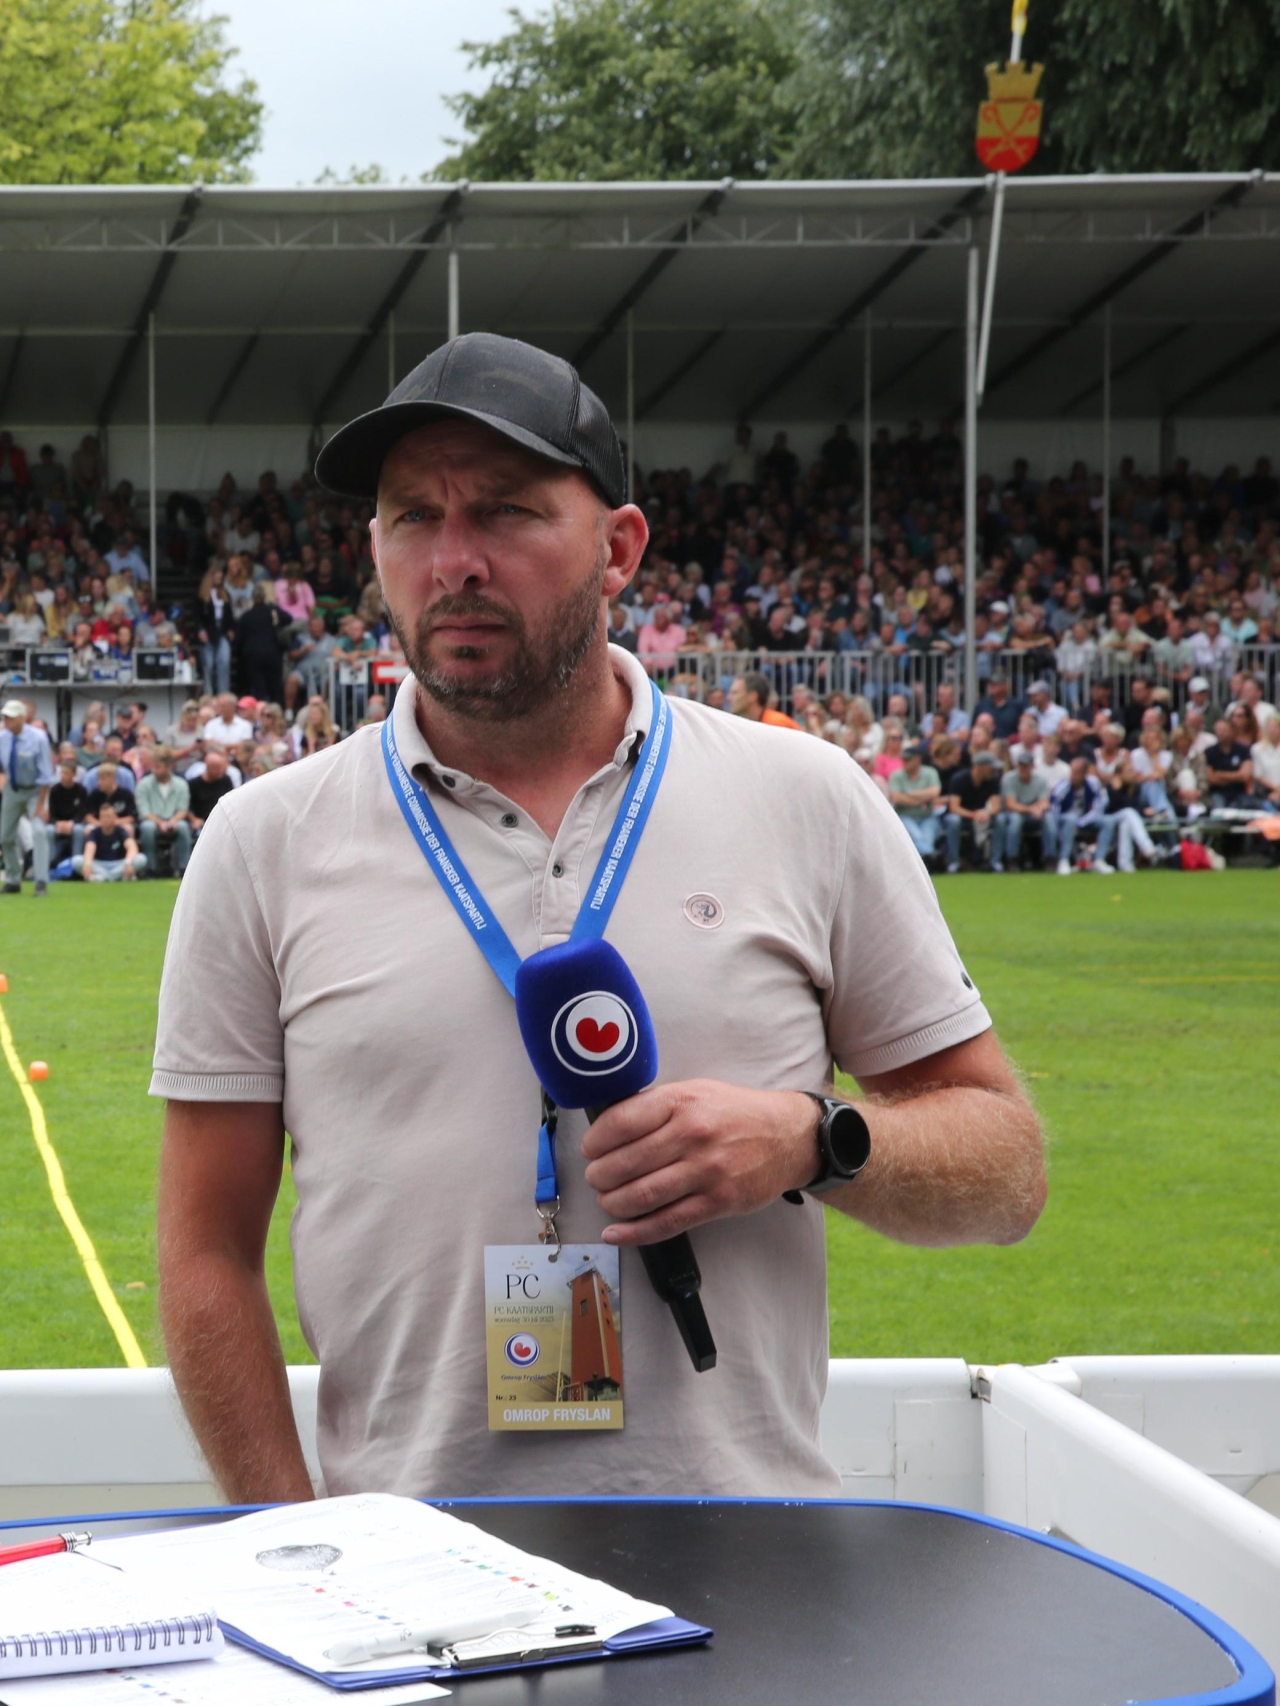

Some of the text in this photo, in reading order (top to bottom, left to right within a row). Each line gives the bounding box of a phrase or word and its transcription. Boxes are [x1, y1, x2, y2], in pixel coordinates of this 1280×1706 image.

[632, 764, 655, 804] COMMISSIE
[626, 801, 641, 819] DER
[391, 752, 487, 930] PERMANENTE COMMISSIE DER FRANEKER KAATSPARTIJ
[610, 817, 635, 859] FRANEKER
[590, 858, 619, 911] KAATSPARTIJ
[505, 1273, 541, 1300] PC
[494, 1305, 504, 1314] PC
[503, 1407, 611, 1422] OMROP FRYSLAN
